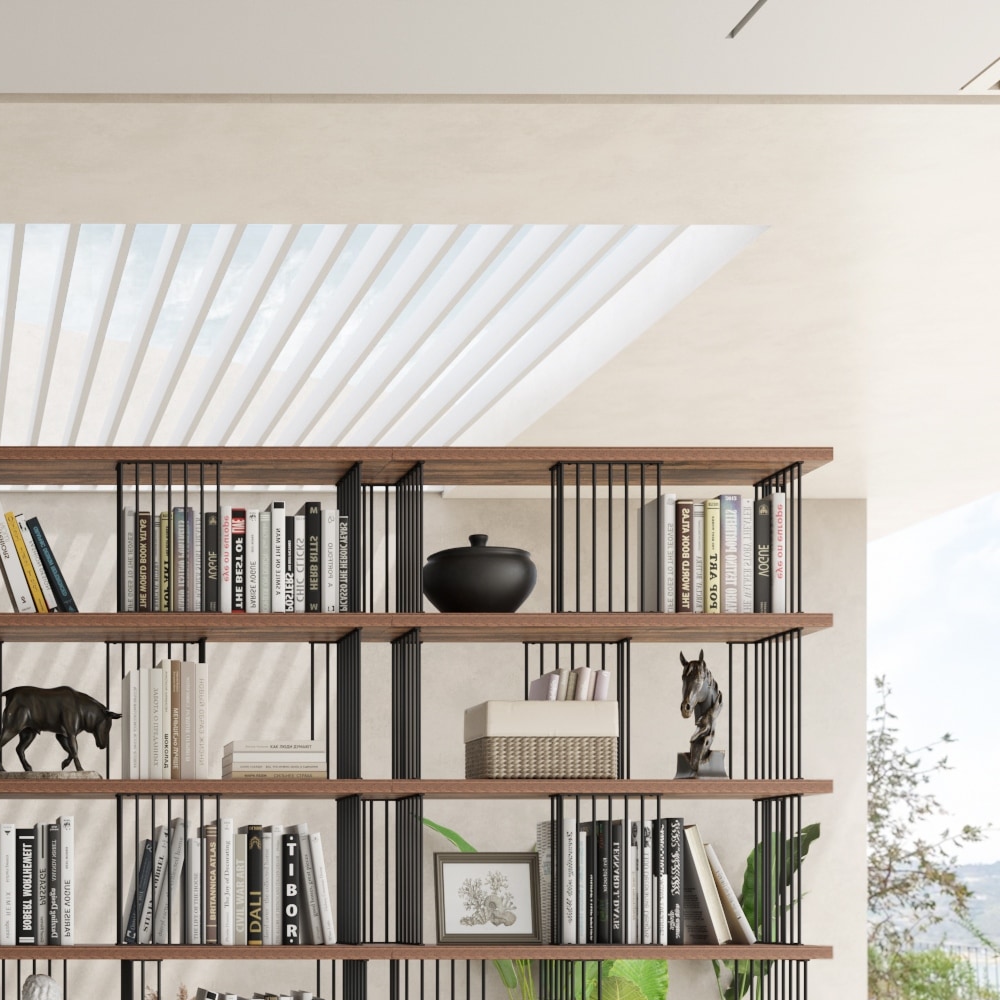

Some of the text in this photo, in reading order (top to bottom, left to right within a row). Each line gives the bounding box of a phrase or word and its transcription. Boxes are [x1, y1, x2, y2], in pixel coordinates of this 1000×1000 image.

[236, 859, 245, 932] CIVIL WAR ART
[249, 891, 261, 933] DALI
[285, 842, 298, 937] TIBOR
